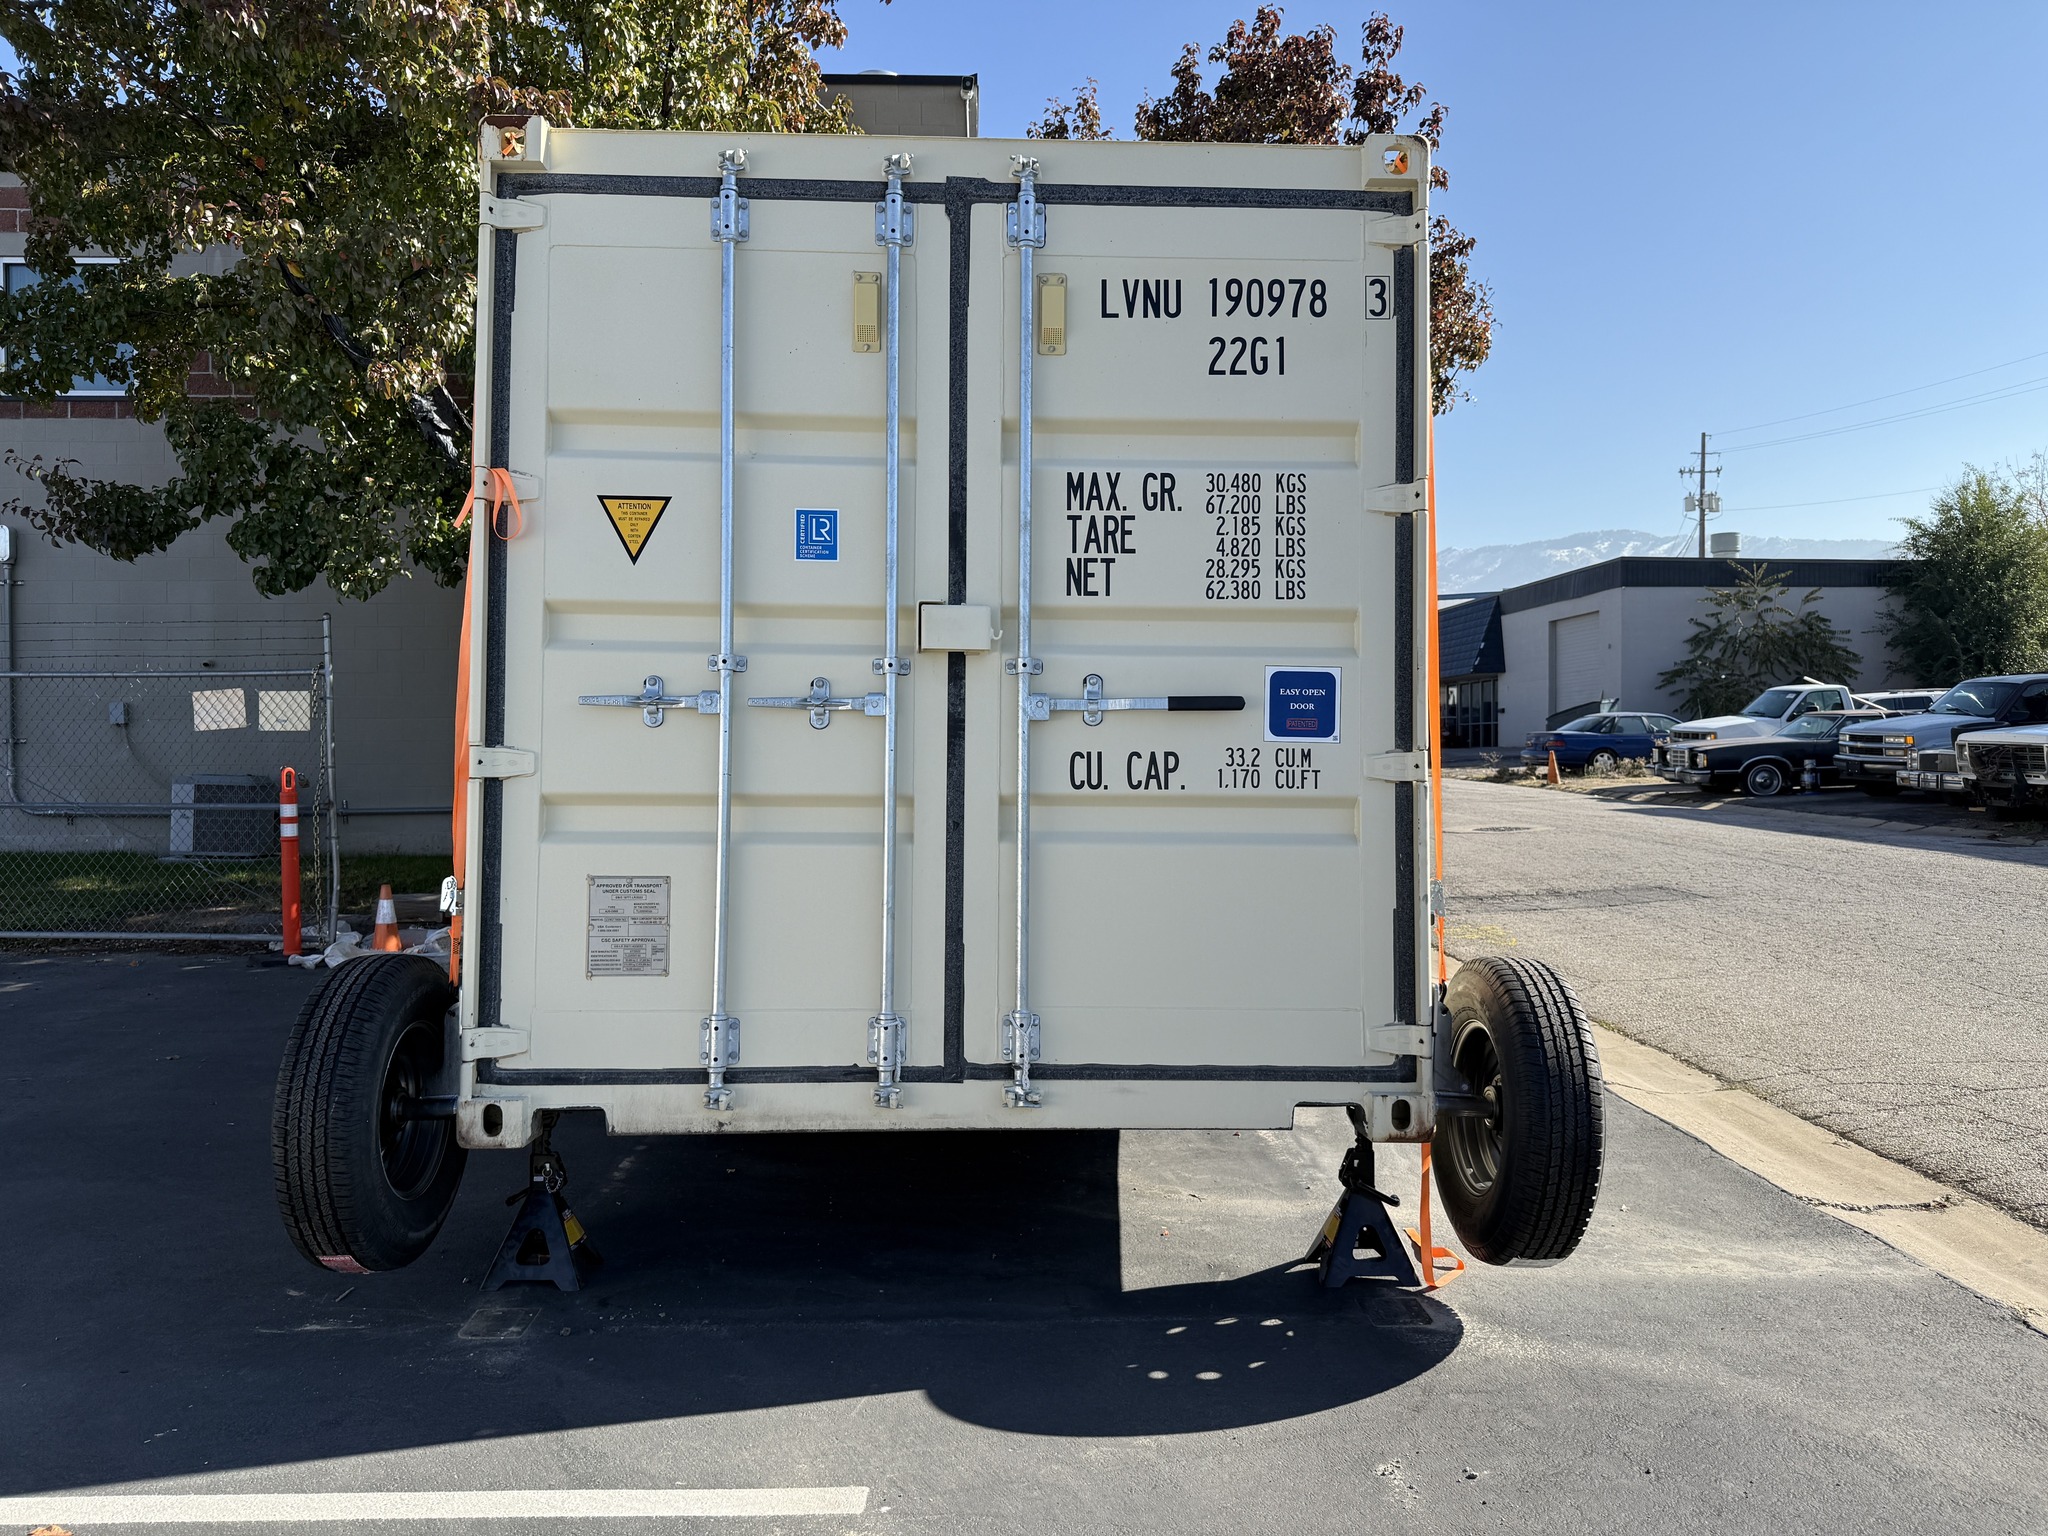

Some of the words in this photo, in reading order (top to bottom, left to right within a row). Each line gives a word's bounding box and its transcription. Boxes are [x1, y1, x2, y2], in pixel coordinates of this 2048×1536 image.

[1101, 279, 1182, 319] LVNU
[1209, 278, 1328, 318] 190978
[1368, 278, 1388, 317] 3
[1208, 336, 1286, 376] 22G1
[1066, 471, 1127, 512] MAX.
[1142, 472, 1182, 512] GR.
[1206, 473, 1261, 493] 30,480
[1275, 473, 1306, 493] KGS
[1205, 494, 1261, 514] 67,200
[1275, 495, 1306, 514] LBS
[812, 518, 831, 541] LR
[1066, 515, 1136, 554] TARE
[1216, 516, 1261, 536] 2,185
[1275, 516, 1306, 536] KGS
[1216, 537, 1261, 557] 4,820
[1275, 537, 1306, 557] LBS
[1066, 557, 1116, 597] NET
[1205, 558, 1261, 579] 28,295
[1275, 559, 1306, 579] KGS
[1205, 580, 1261, 600] 62,380
[1275, 580, 1306, 600] LBS
[1280, 688, 1301, 696] EASY
[1302, 688, 1326, 696] OPEN
[1288, 720, 1317, 728] PATENTED
[1225, 747, 1261, 767] 33.2
[1275, 748, 1312, 768] CU.M
[1069, 751, 1108, 791] CU.
[1126, 751, 1186, 791] CAP.
[1218, 768, 1260, 789] 1,170
[1275, 769, 1321, 790] CU.FT
